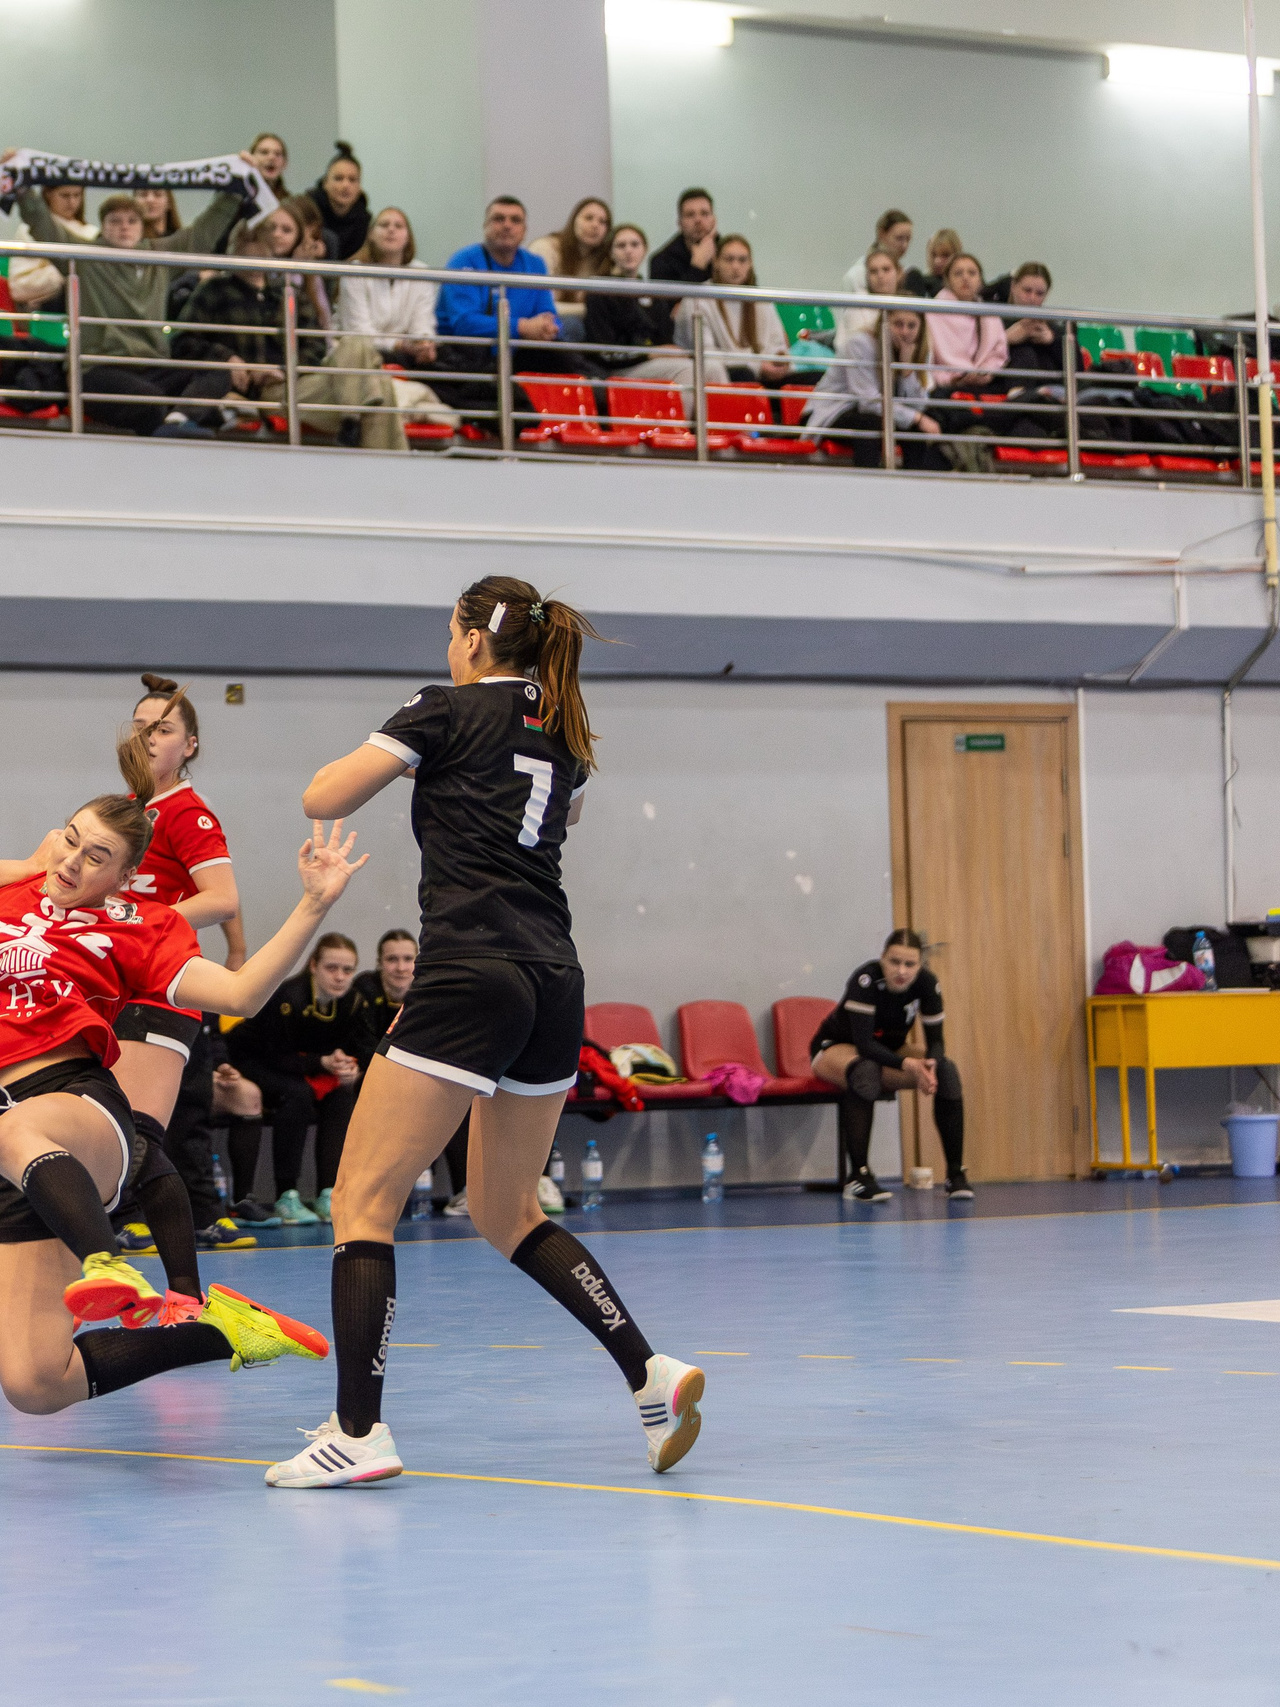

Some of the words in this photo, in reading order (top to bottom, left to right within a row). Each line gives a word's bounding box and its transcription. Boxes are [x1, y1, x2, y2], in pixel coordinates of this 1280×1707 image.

[513, 753, 554, 848] 7
[371, 1296, 397, 1376] Kempa
[571, 1261, 627, 1331] Kempa
